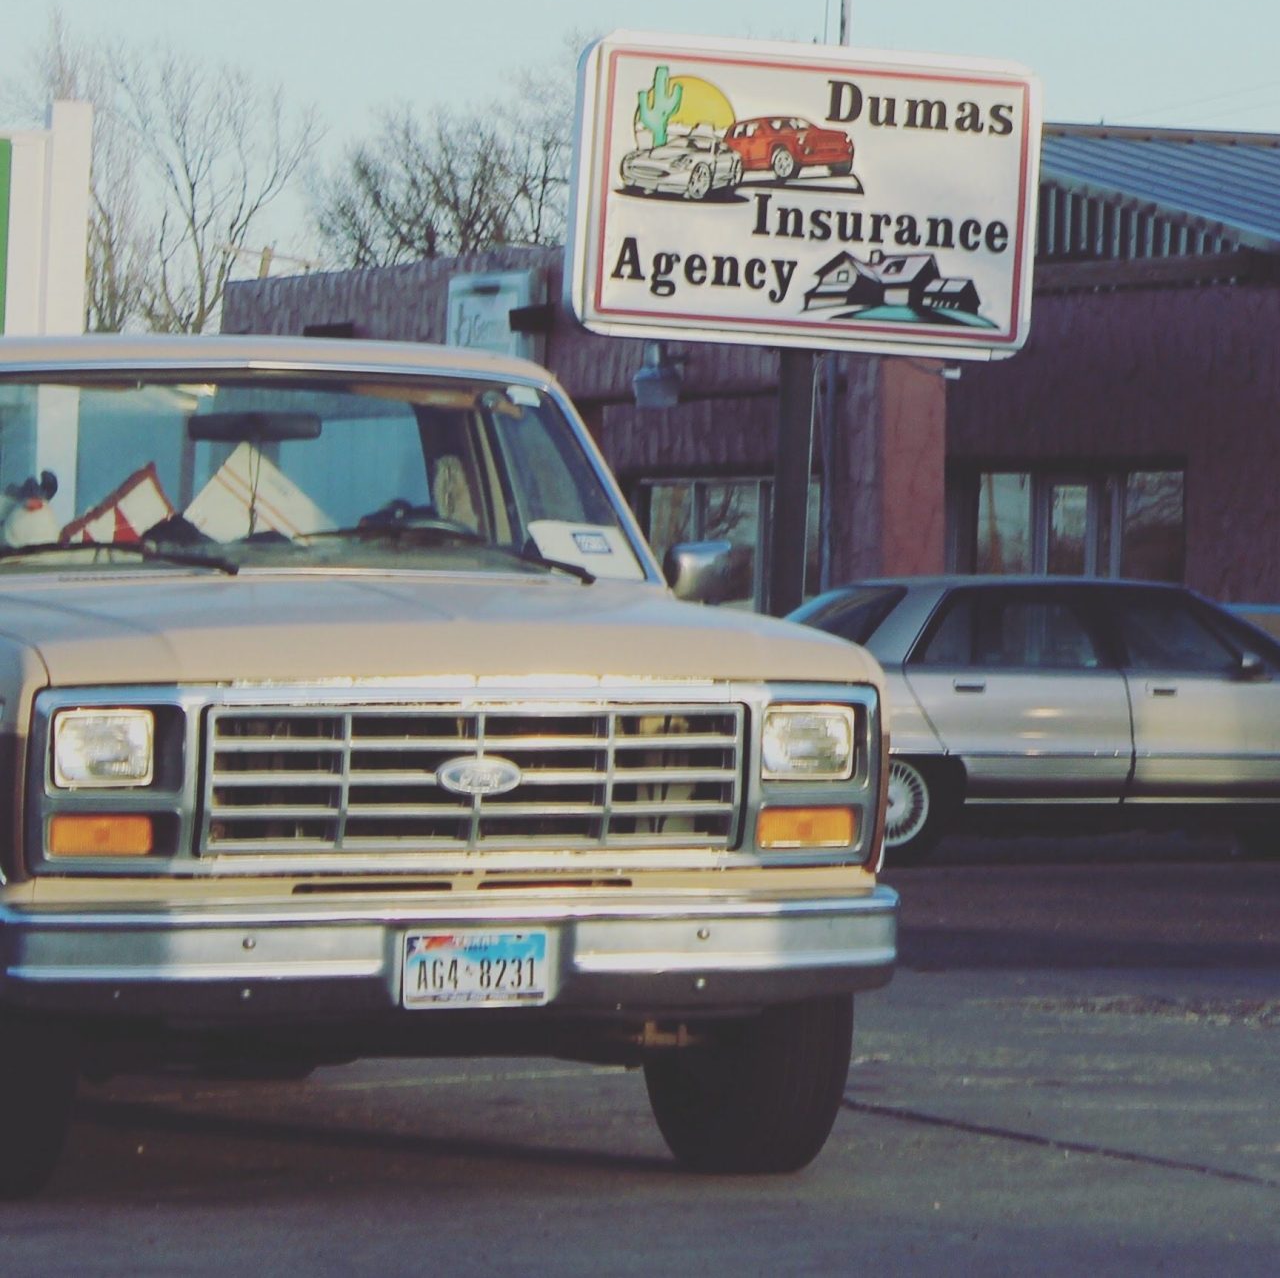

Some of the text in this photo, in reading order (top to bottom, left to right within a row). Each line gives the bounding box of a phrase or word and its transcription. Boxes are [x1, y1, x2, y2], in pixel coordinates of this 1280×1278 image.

[826, 80, 1014, 135] Dumas
[752, 193, 1008, 252] Insurance
[611, 236, 797, 303] Agency
[480, 957, 535, 989] 8231
